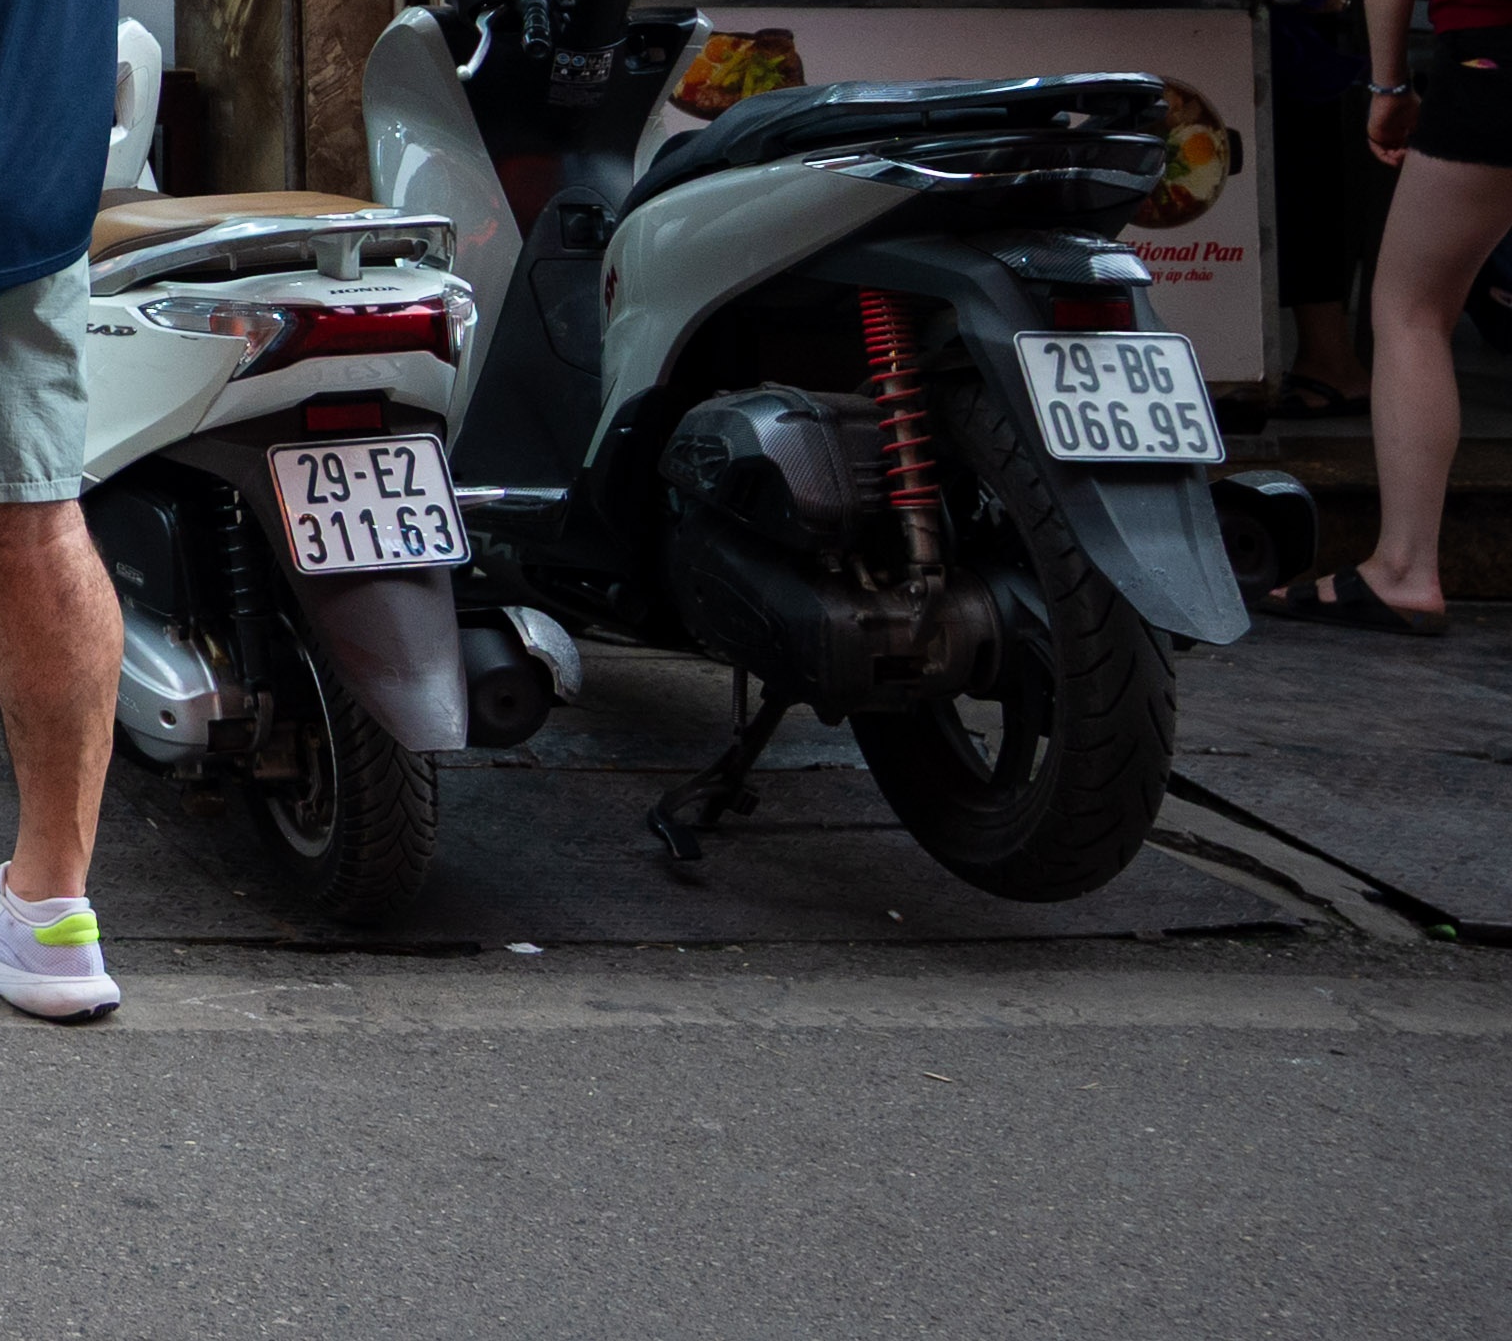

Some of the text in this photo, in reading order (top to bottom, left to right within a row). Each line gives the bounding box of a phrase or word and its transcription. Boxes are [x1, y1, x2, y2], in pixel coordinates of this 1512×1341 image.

[328, 283, 403, 296] HONDA
[1043, 341, 1176, 395] 29-BG
[1048, 399, 1209, 457] 066.95
[297, 446, 427, 505] 29-E2
[297, 503, 456, 566] 311.63
